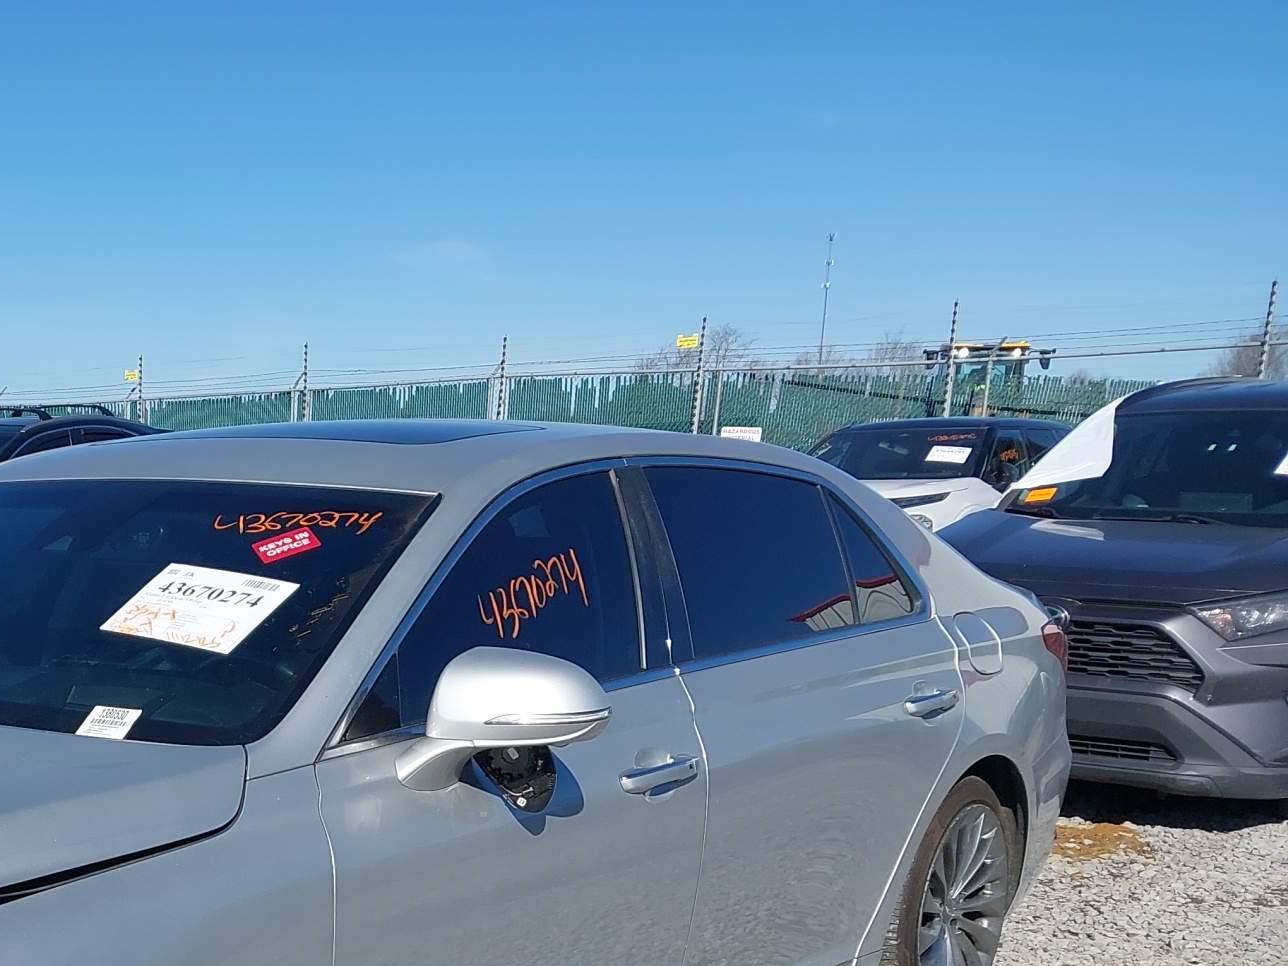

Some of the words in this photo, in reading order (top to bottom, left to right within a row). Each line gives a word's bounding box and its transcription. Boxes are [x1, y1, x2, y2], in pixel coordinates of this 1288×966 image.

[213, 511, 384, 535] 43670274
[258, 536, 293, 552] KEYS
[295, 531, 311, 541] IN
[266, 539, 312, 557] OFFICE
[158, 581, 265, 608] 43670274
[477, 548, 589, 638] 43670274
